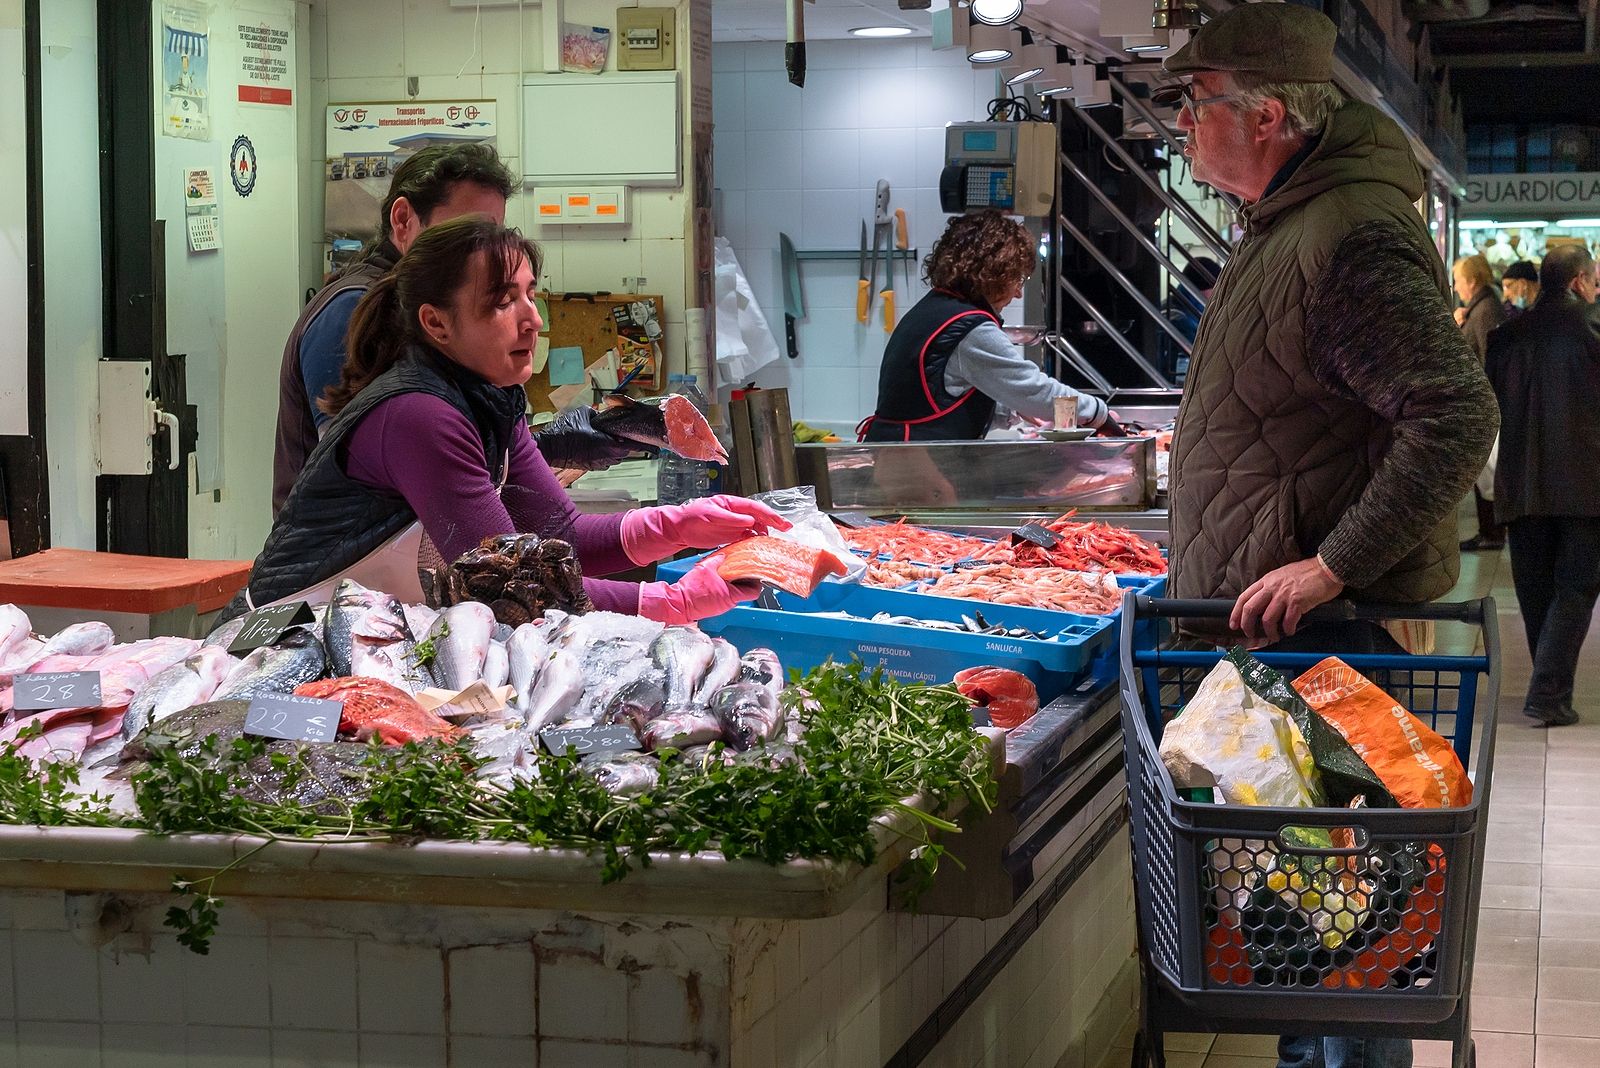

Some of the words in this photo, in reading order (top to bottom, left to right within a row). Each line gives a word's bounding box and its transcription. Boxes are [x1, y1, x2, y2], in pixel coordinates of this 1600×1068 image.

[379, 118, 416, 126] Internacionales
[1465, 180, 1600, 203] GUARDIOLA
[878, 646, 911, 657] PESQUERA
[879, 657, 888, 665] DE
[248, 707, 288, 736] 22
